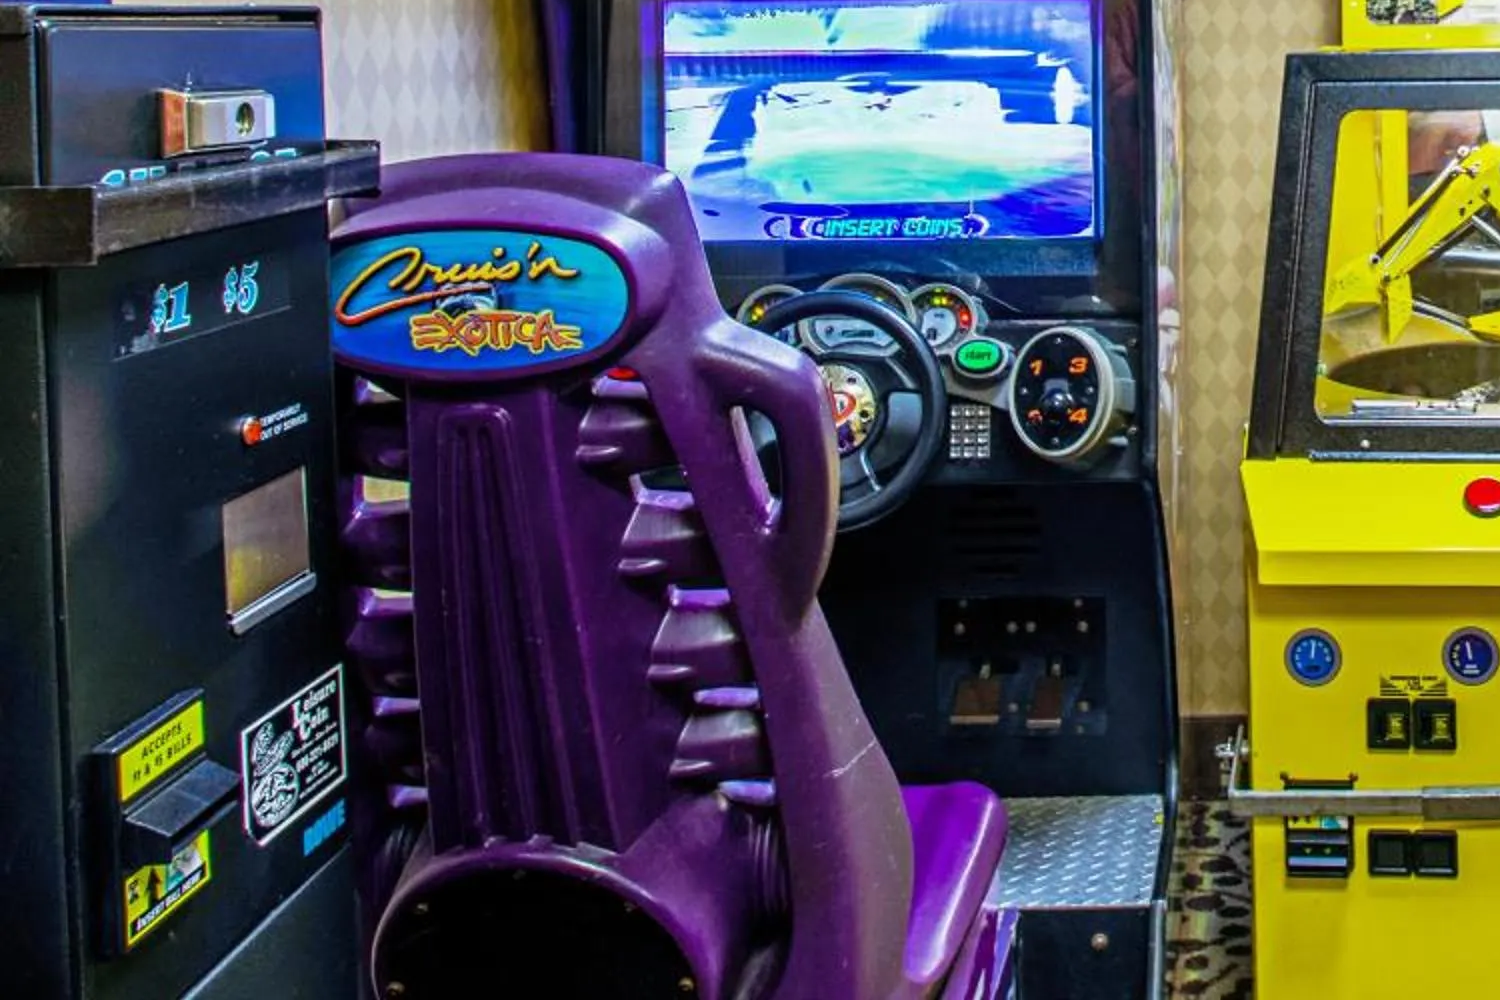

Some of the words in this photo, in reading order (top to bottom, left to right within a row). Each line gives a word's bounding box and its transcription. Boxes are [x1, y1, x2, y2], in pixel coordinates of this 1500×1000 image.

[824, 217, 895, 238] INSERT
[903, 216, 965, 238] COINS
[151, 280, 191, 334] $1
[223, 260, 260, 315] $5
[334, 240, 579, 327] Cruis'n
[409, 308, 584, 356] EXOTICA
[1028, 358, 1044, 376] 1
[1067, 356, 1089, 375] 3
[1067, 407, 1089, 425] 4
[141, 722, 182, 759] ACCEPTS
[166, 732, 192, 760] BILLS
